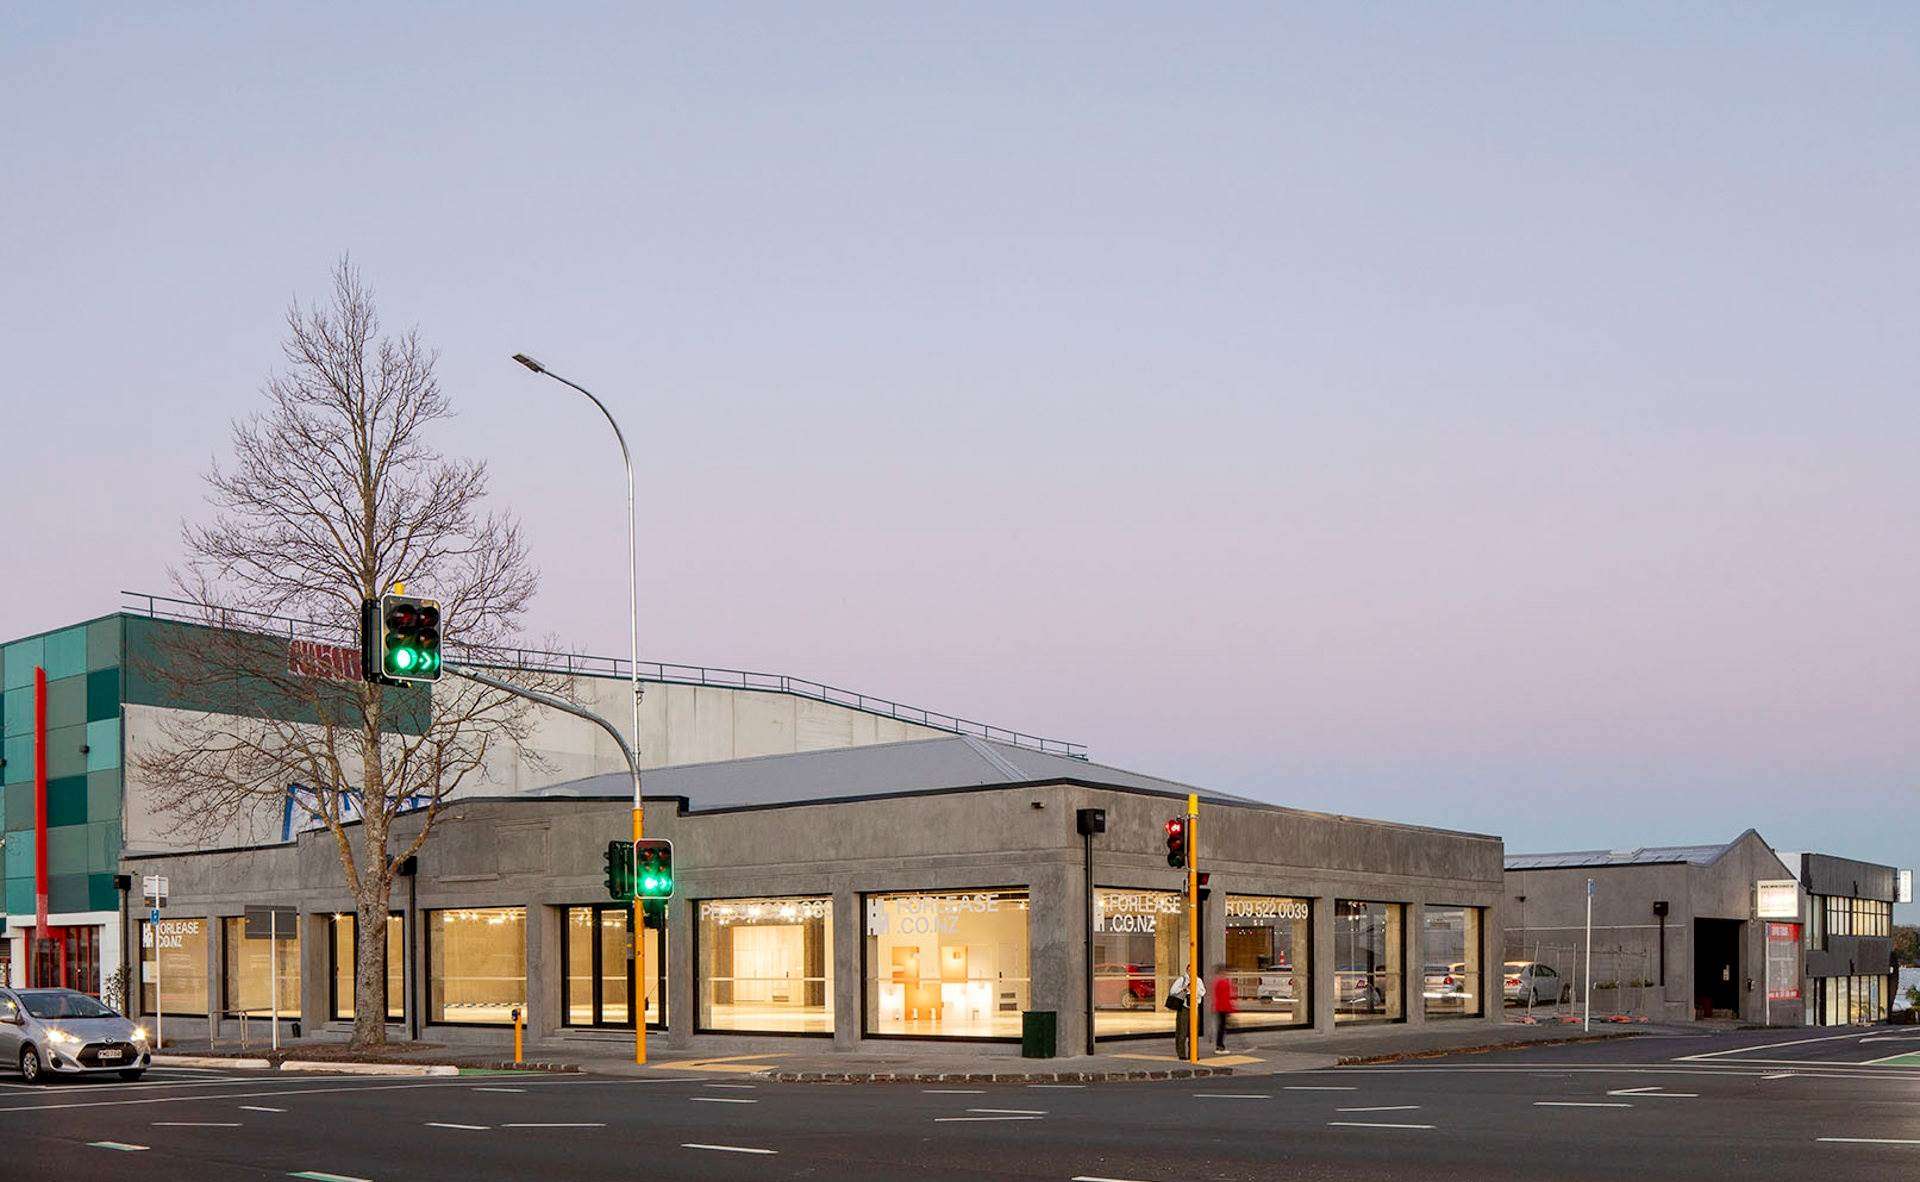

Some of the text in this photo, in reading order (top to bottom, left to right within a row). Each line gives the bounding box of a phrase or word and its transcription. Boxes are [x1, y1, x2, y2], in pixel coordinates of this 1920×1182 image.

[1237, 901, 1253, 917] 09
[1255, 901, 1276, 918] 522
[1278, 903, 1308, 919] 0039
[158, 922, 199, 935] ORLEASE
